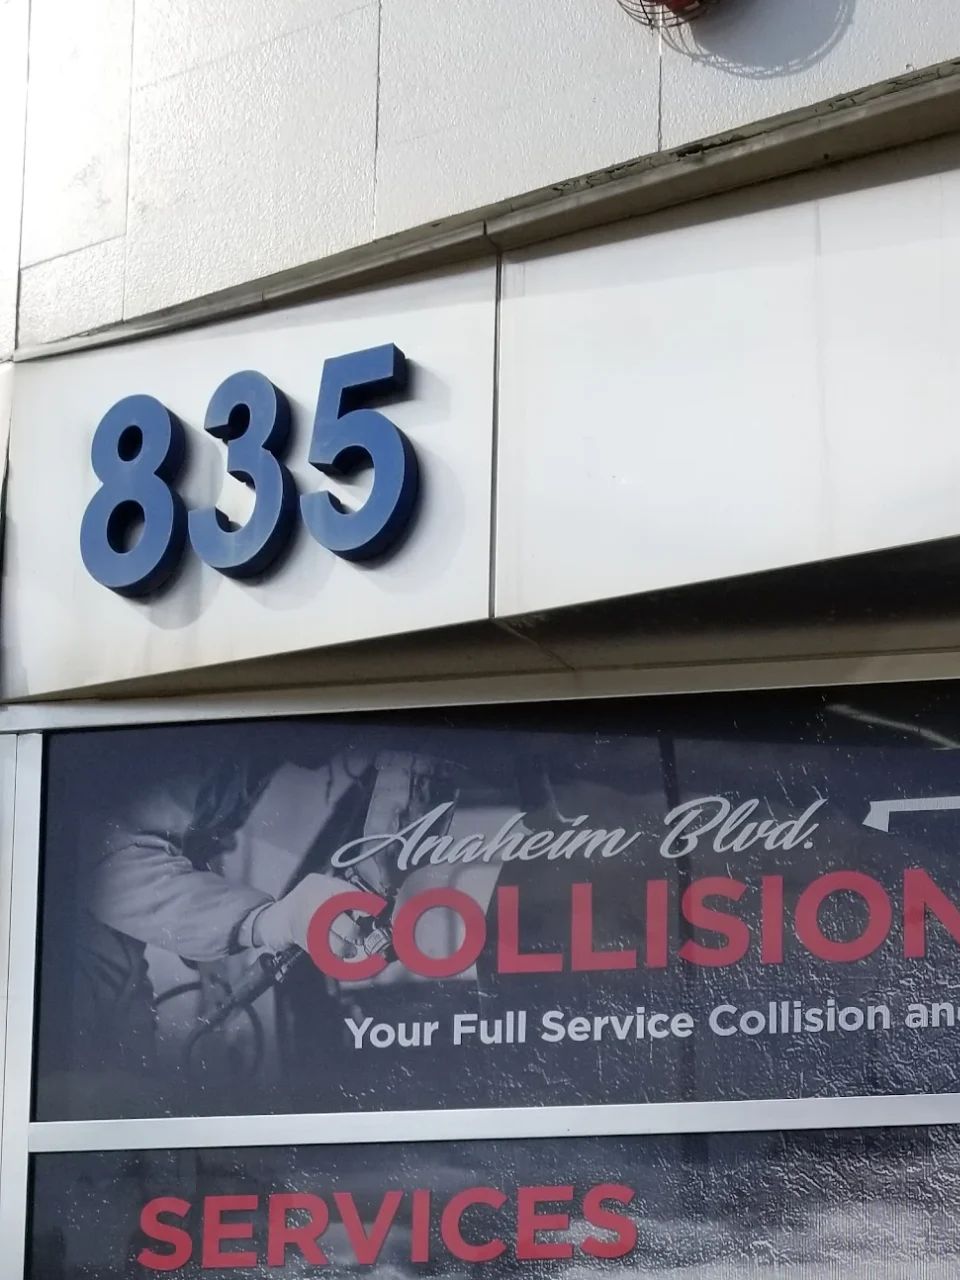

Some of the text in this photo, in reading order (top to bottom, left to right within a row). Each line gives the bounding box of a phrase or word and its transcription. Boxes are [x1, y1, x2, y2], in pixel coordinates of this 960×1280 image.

[80, 343, 419, 598] 835
[331, 795, 828, 870] Anaheim Blvd.
[344, 1015, 438, 1049] Your
[453, 1010, 526, 1044] Full
[541, 1006, 694, 1042] Service
[708, 999, 890, 1037] Collision
[136, 1184, 637, 1271] SERVICES
